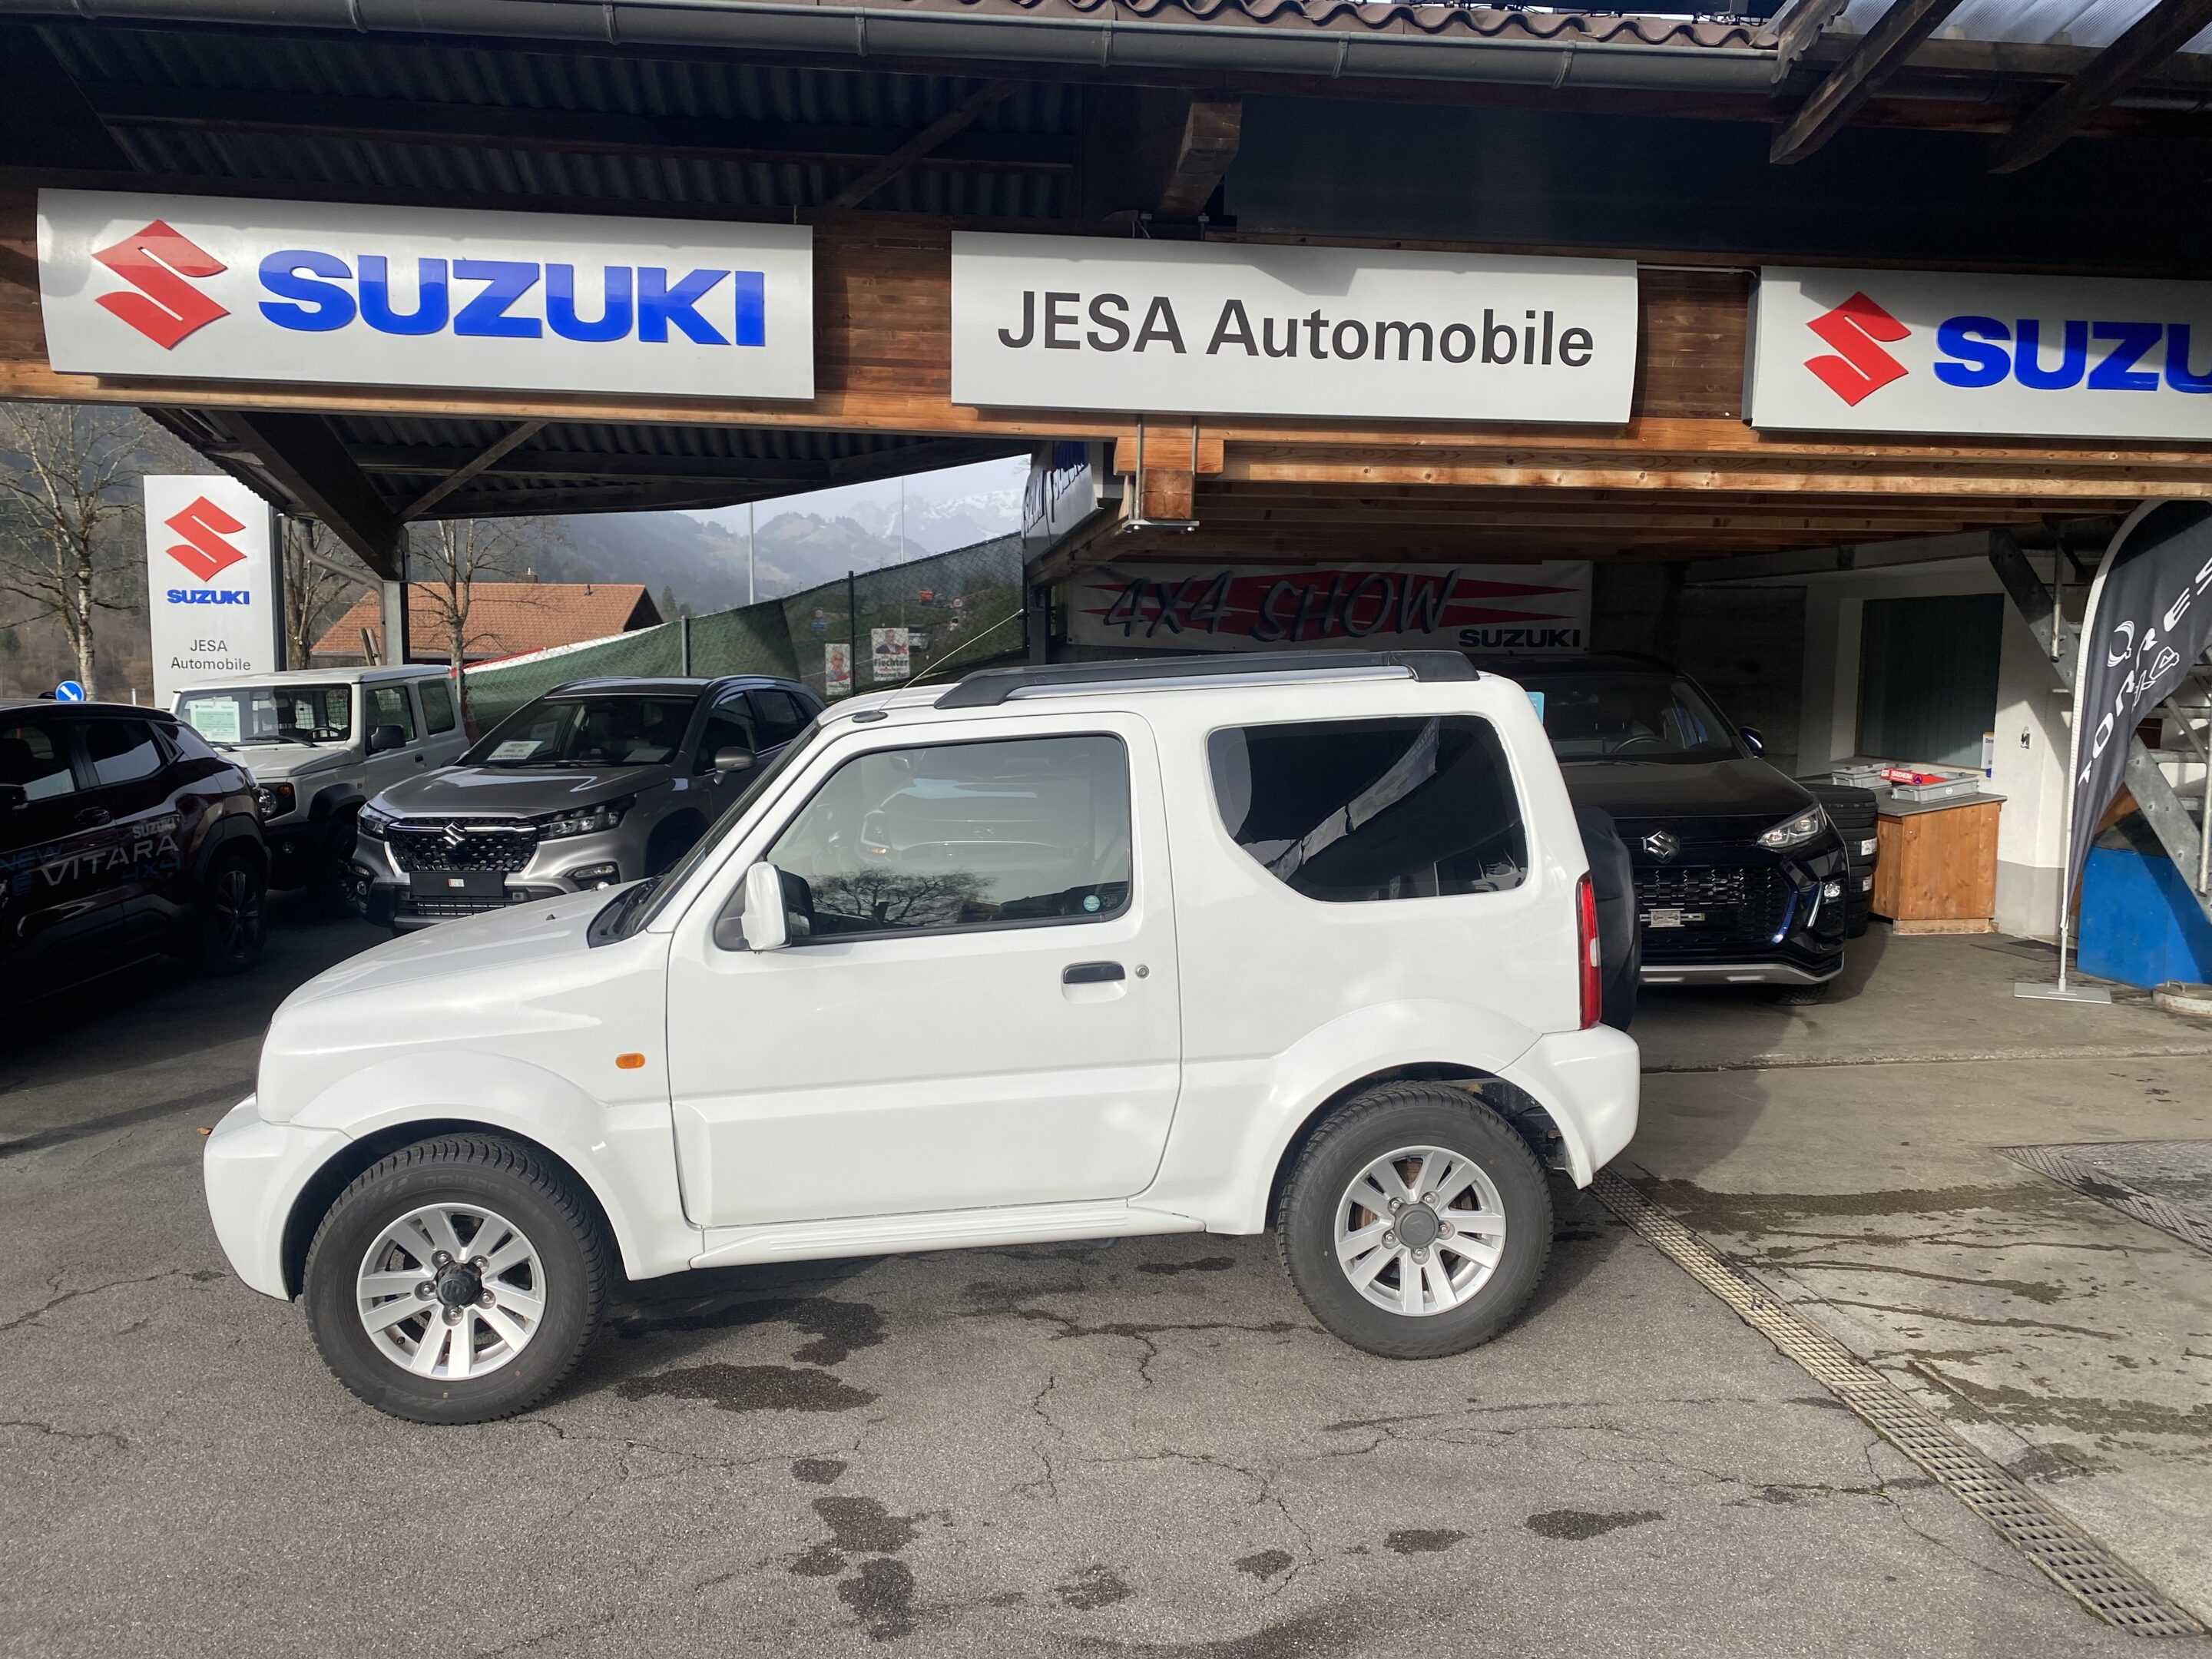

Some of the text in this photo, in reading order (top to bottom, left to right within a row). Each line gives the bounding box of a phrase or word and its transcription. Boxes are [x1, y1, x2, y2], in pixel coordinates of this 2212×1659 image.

[258, 249, 766, 348] SUZUKI
[997, 290, 1594, 368] JESA Automobile
[1932, 316, 2212, 394] SUZU
[167, 589, 250, 605] SUZUKI
[1103, 567, 1462, 643] 4X4 SHOW
[190, 639, 228, 652] JESA
[1459, 628, 1581, 648] SUZUKI
[171, 657, 252, 671] Automobile
[1891, 770, 1913, 780] SIDEM
[131, 816, 177, 839] SUZUKI
[41, 834, 180, 886] VITARA
